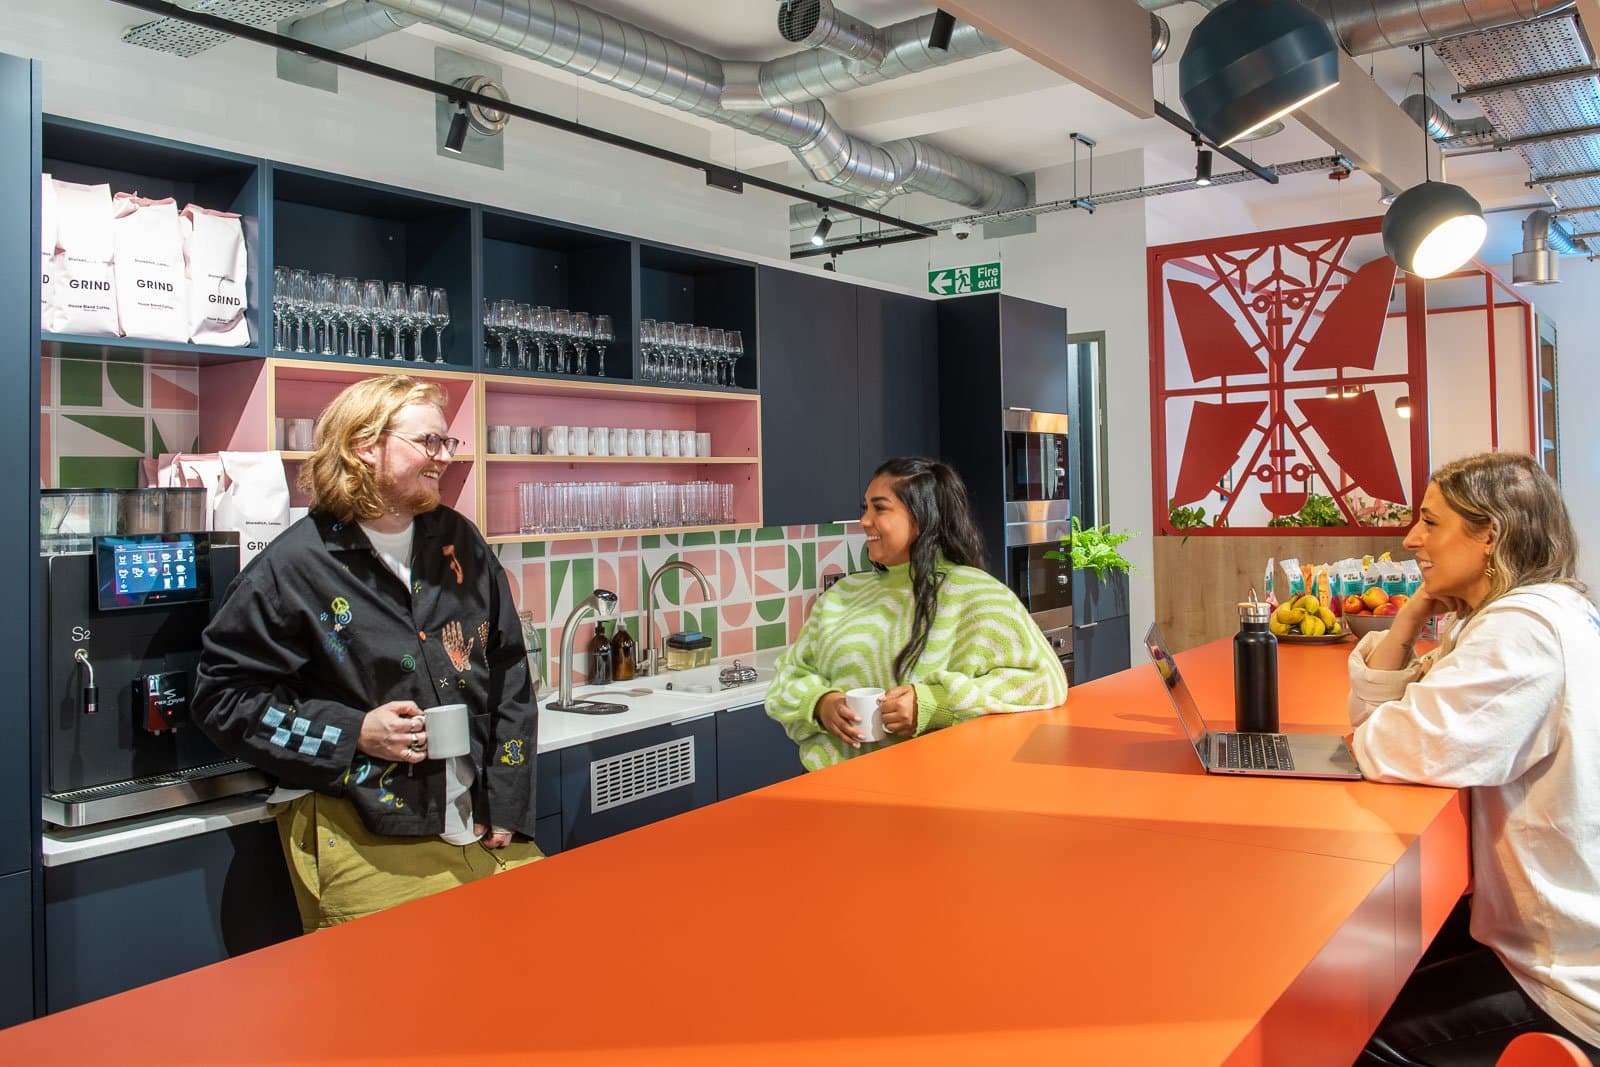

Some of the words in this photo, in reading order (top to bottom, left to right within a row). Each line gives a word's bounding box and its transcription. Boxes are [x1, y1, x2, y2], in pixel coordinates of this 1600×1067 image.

[977, 266, 999, 278] Fire
[69, 279, 111, 291] GRIND
[136, 279, 174, 292] GRIND
[978, 277, 998, 288] exit
[208, 294, 241, 306] GRIND
